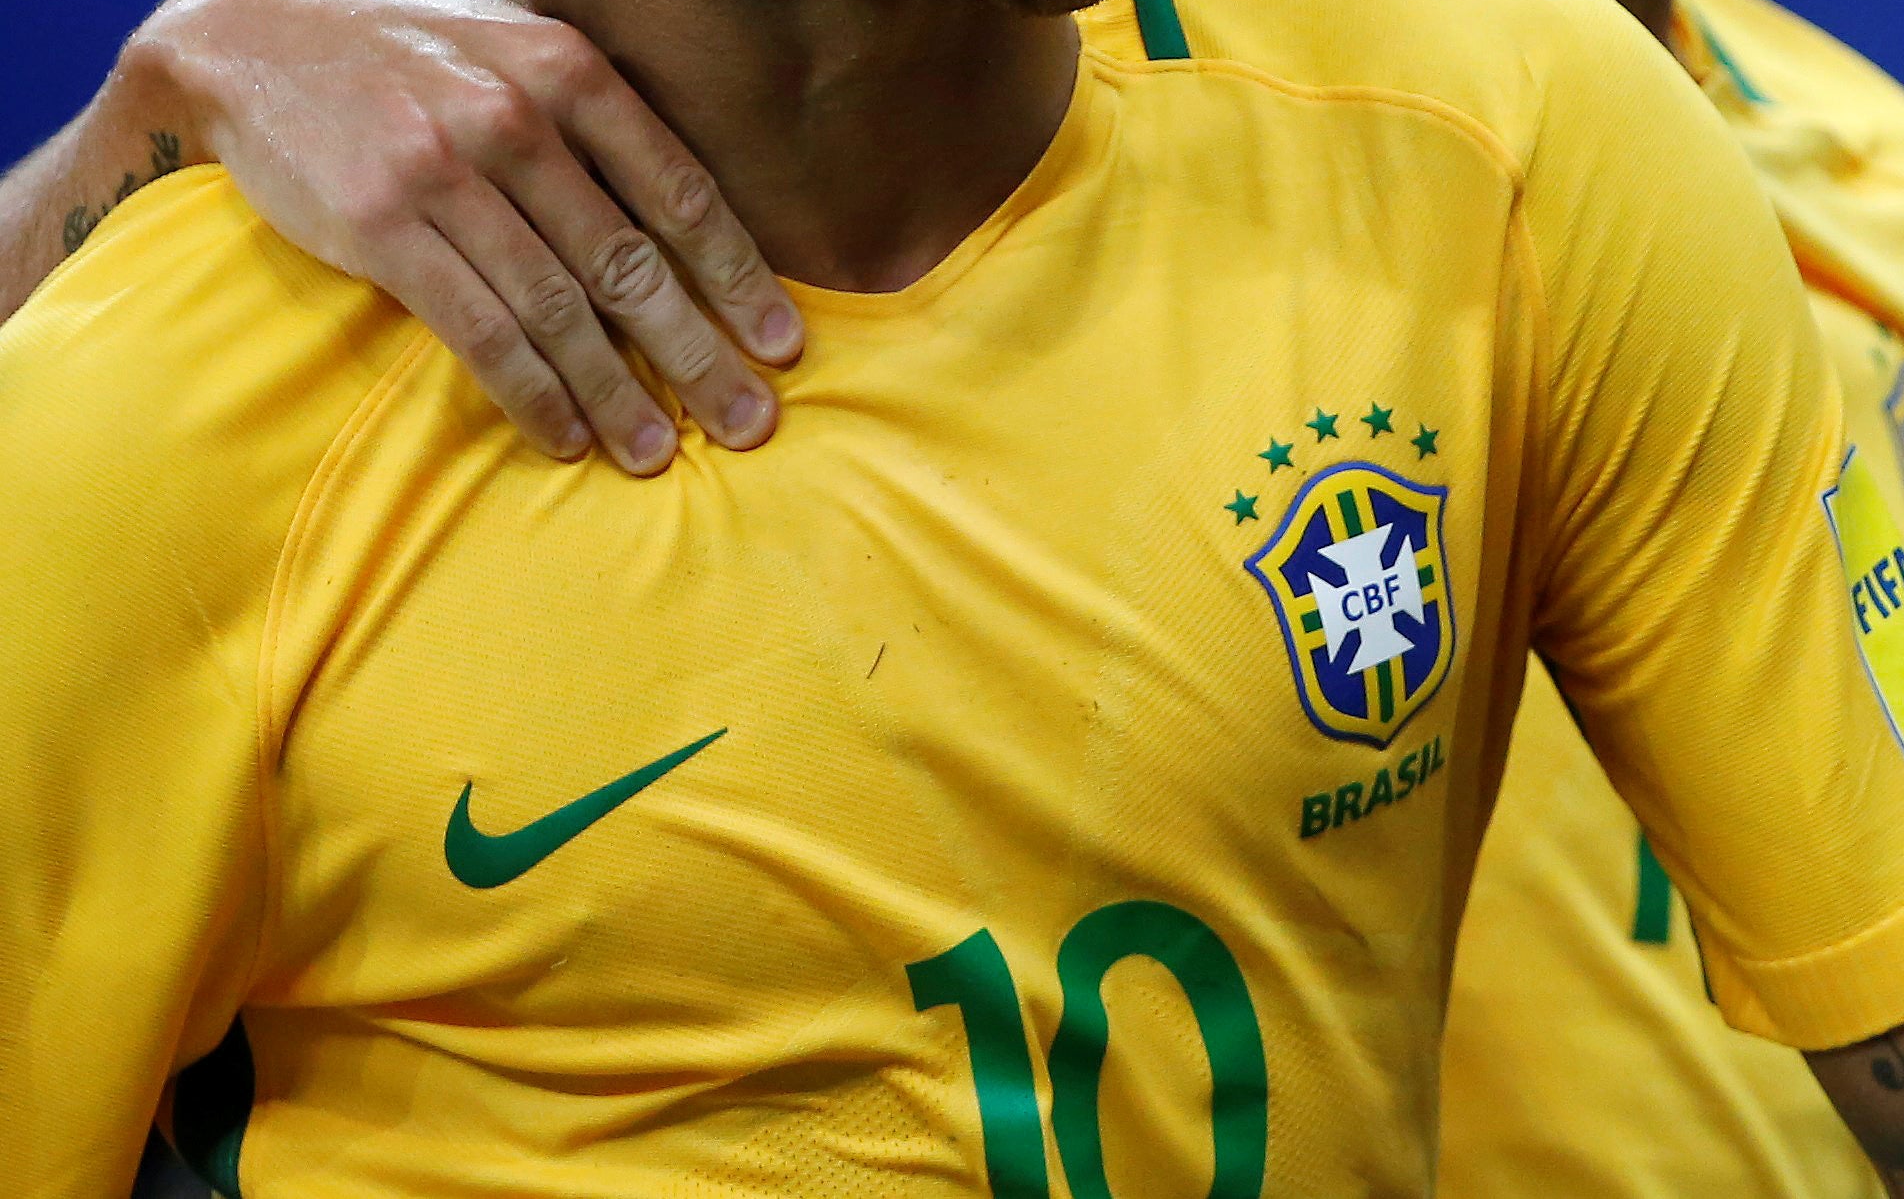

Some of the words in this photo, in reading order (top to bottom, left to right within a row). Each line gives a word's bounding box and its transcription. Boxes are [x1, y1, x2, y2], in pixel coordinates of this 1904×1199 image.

[1342, 574, 1401, 621] CBF
[1301, 736, 1445, 839] BRASIL
[905, 899, 1268, 1199] 10
